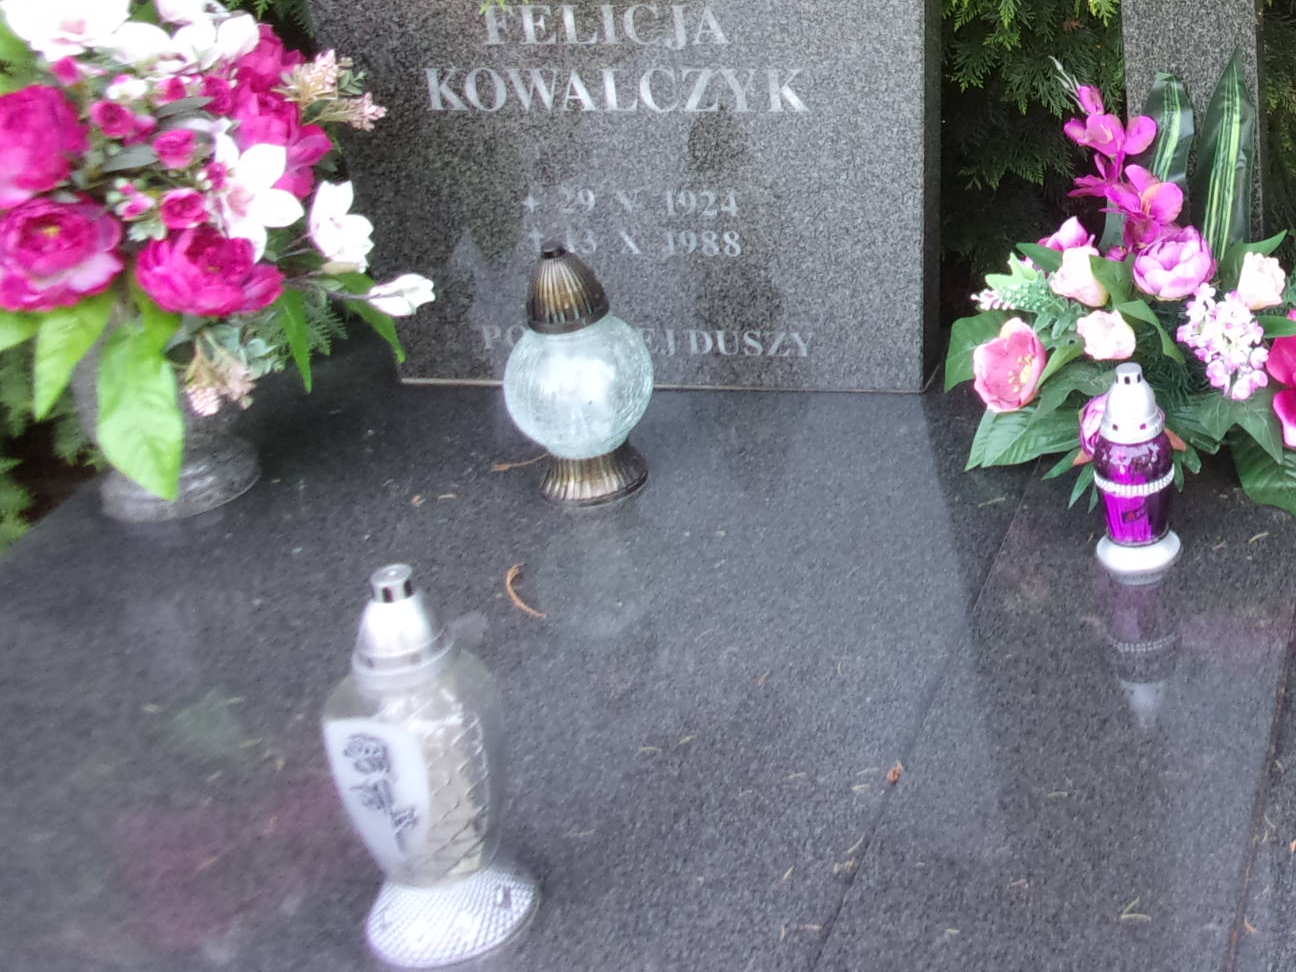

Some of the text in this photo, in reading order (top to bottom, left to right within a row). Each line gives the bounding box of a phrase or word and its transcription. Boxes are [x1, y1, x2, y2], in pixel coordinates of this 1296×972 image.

[482, 4, 731, 51] FELICJA
[422, 67, 810, 114] KOWALCZYK
[664, 188, 740, 218] 1924
[618, 229, 642, 256] X
[664, 230, 742, 258] 1988
[686, 329, 816, 358] DUSZY
